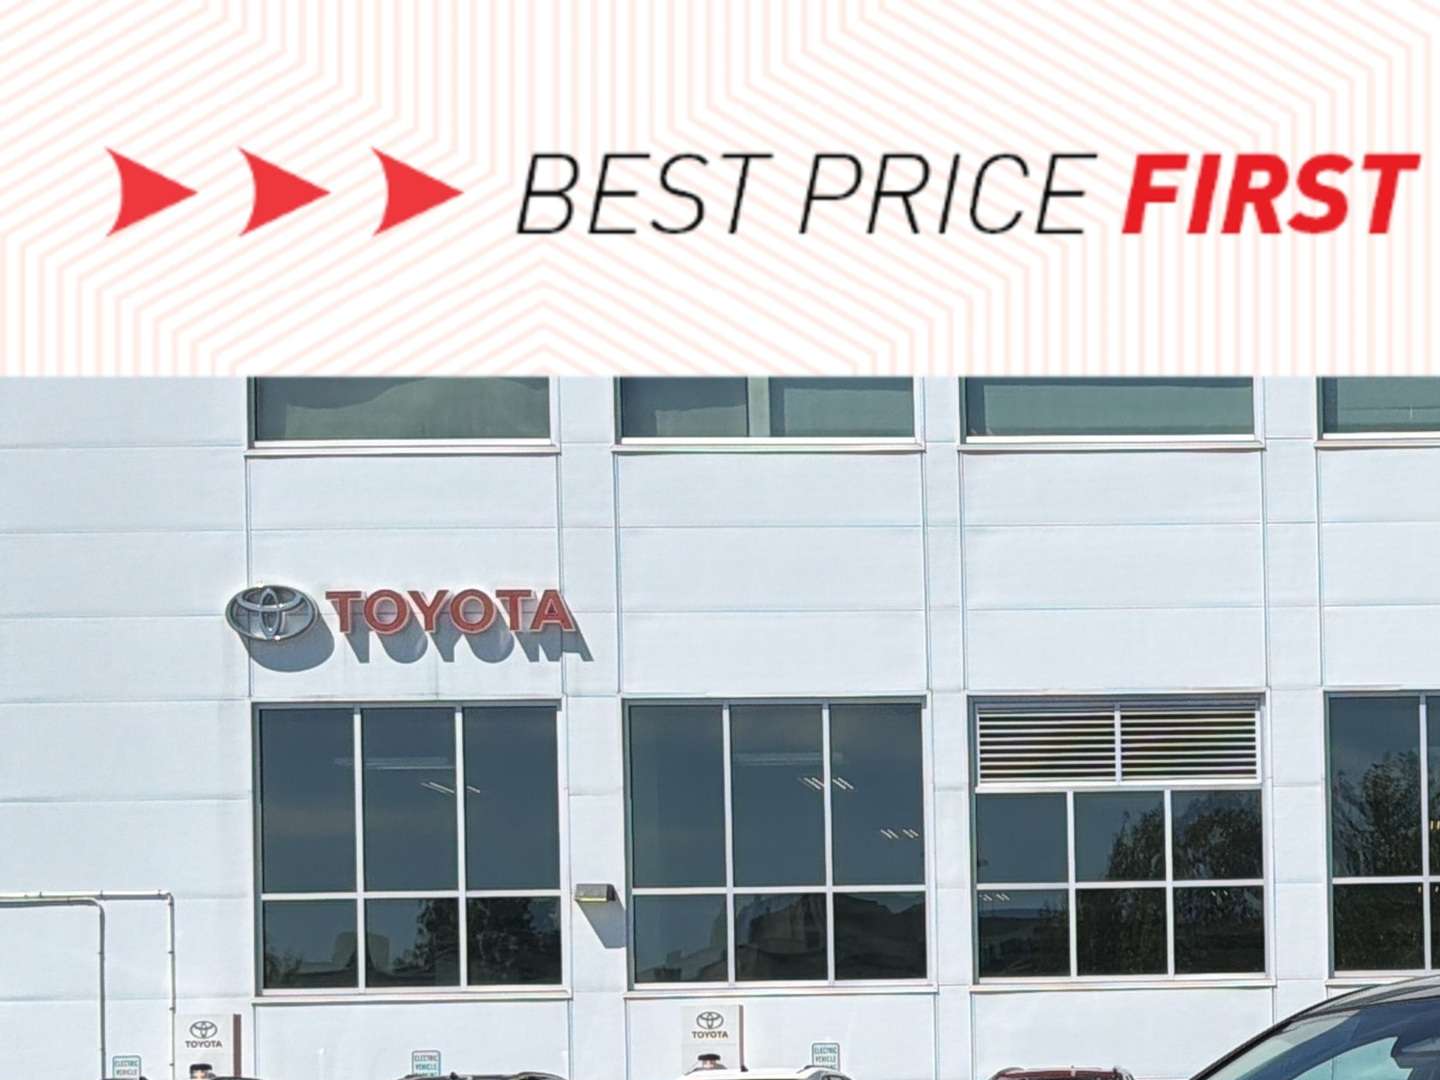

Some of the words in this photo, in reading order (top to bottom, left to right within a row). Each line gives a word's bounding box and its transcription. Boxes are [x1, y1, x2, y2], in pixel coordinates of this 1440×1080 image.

[325, 588, 577, 635] TOYOTA
[691, 1030, 729, 1039] TOYOTA
[185, 1040, 223, 1048] TOYOTA
